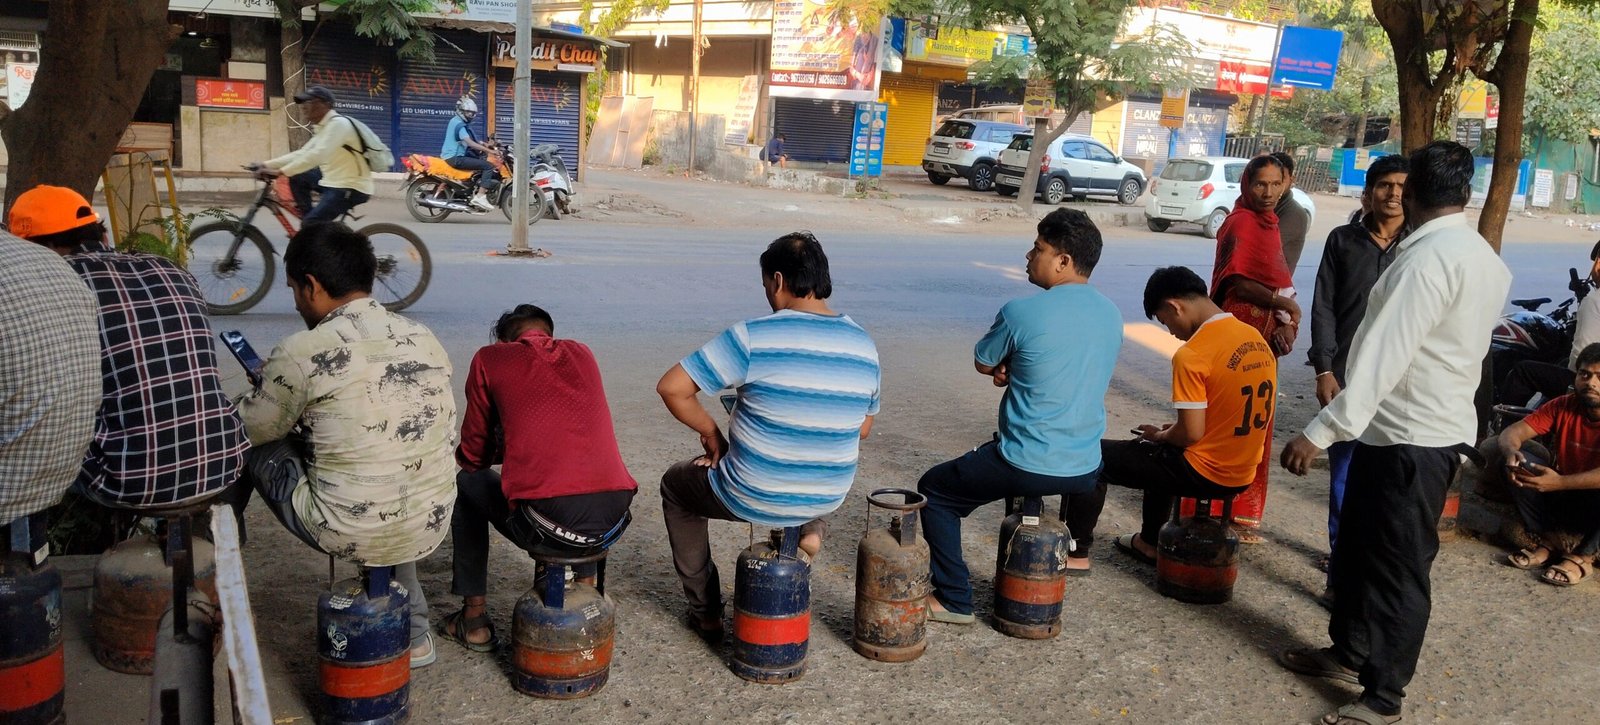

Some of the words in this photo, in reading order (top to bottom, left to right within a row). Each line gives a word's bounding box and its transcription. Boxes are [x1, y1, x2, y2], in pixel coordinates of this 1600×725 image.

[498, 41, 556, 61] Pdit
[560, 42, 598, 63] Chai
[931, 43, 954, 52] Hariom
[500, 85, 559, 104] AAVI
[369, 104, 384, 112] FANS
[937, 99, 961, 109] ANZO
[1133, 109, 1161, 121] CLANZ
[1226, 350, 1242, 372] SHREE
[1233, 379, 1274, 437] 13
[555, 527, 588, 544] LUX
